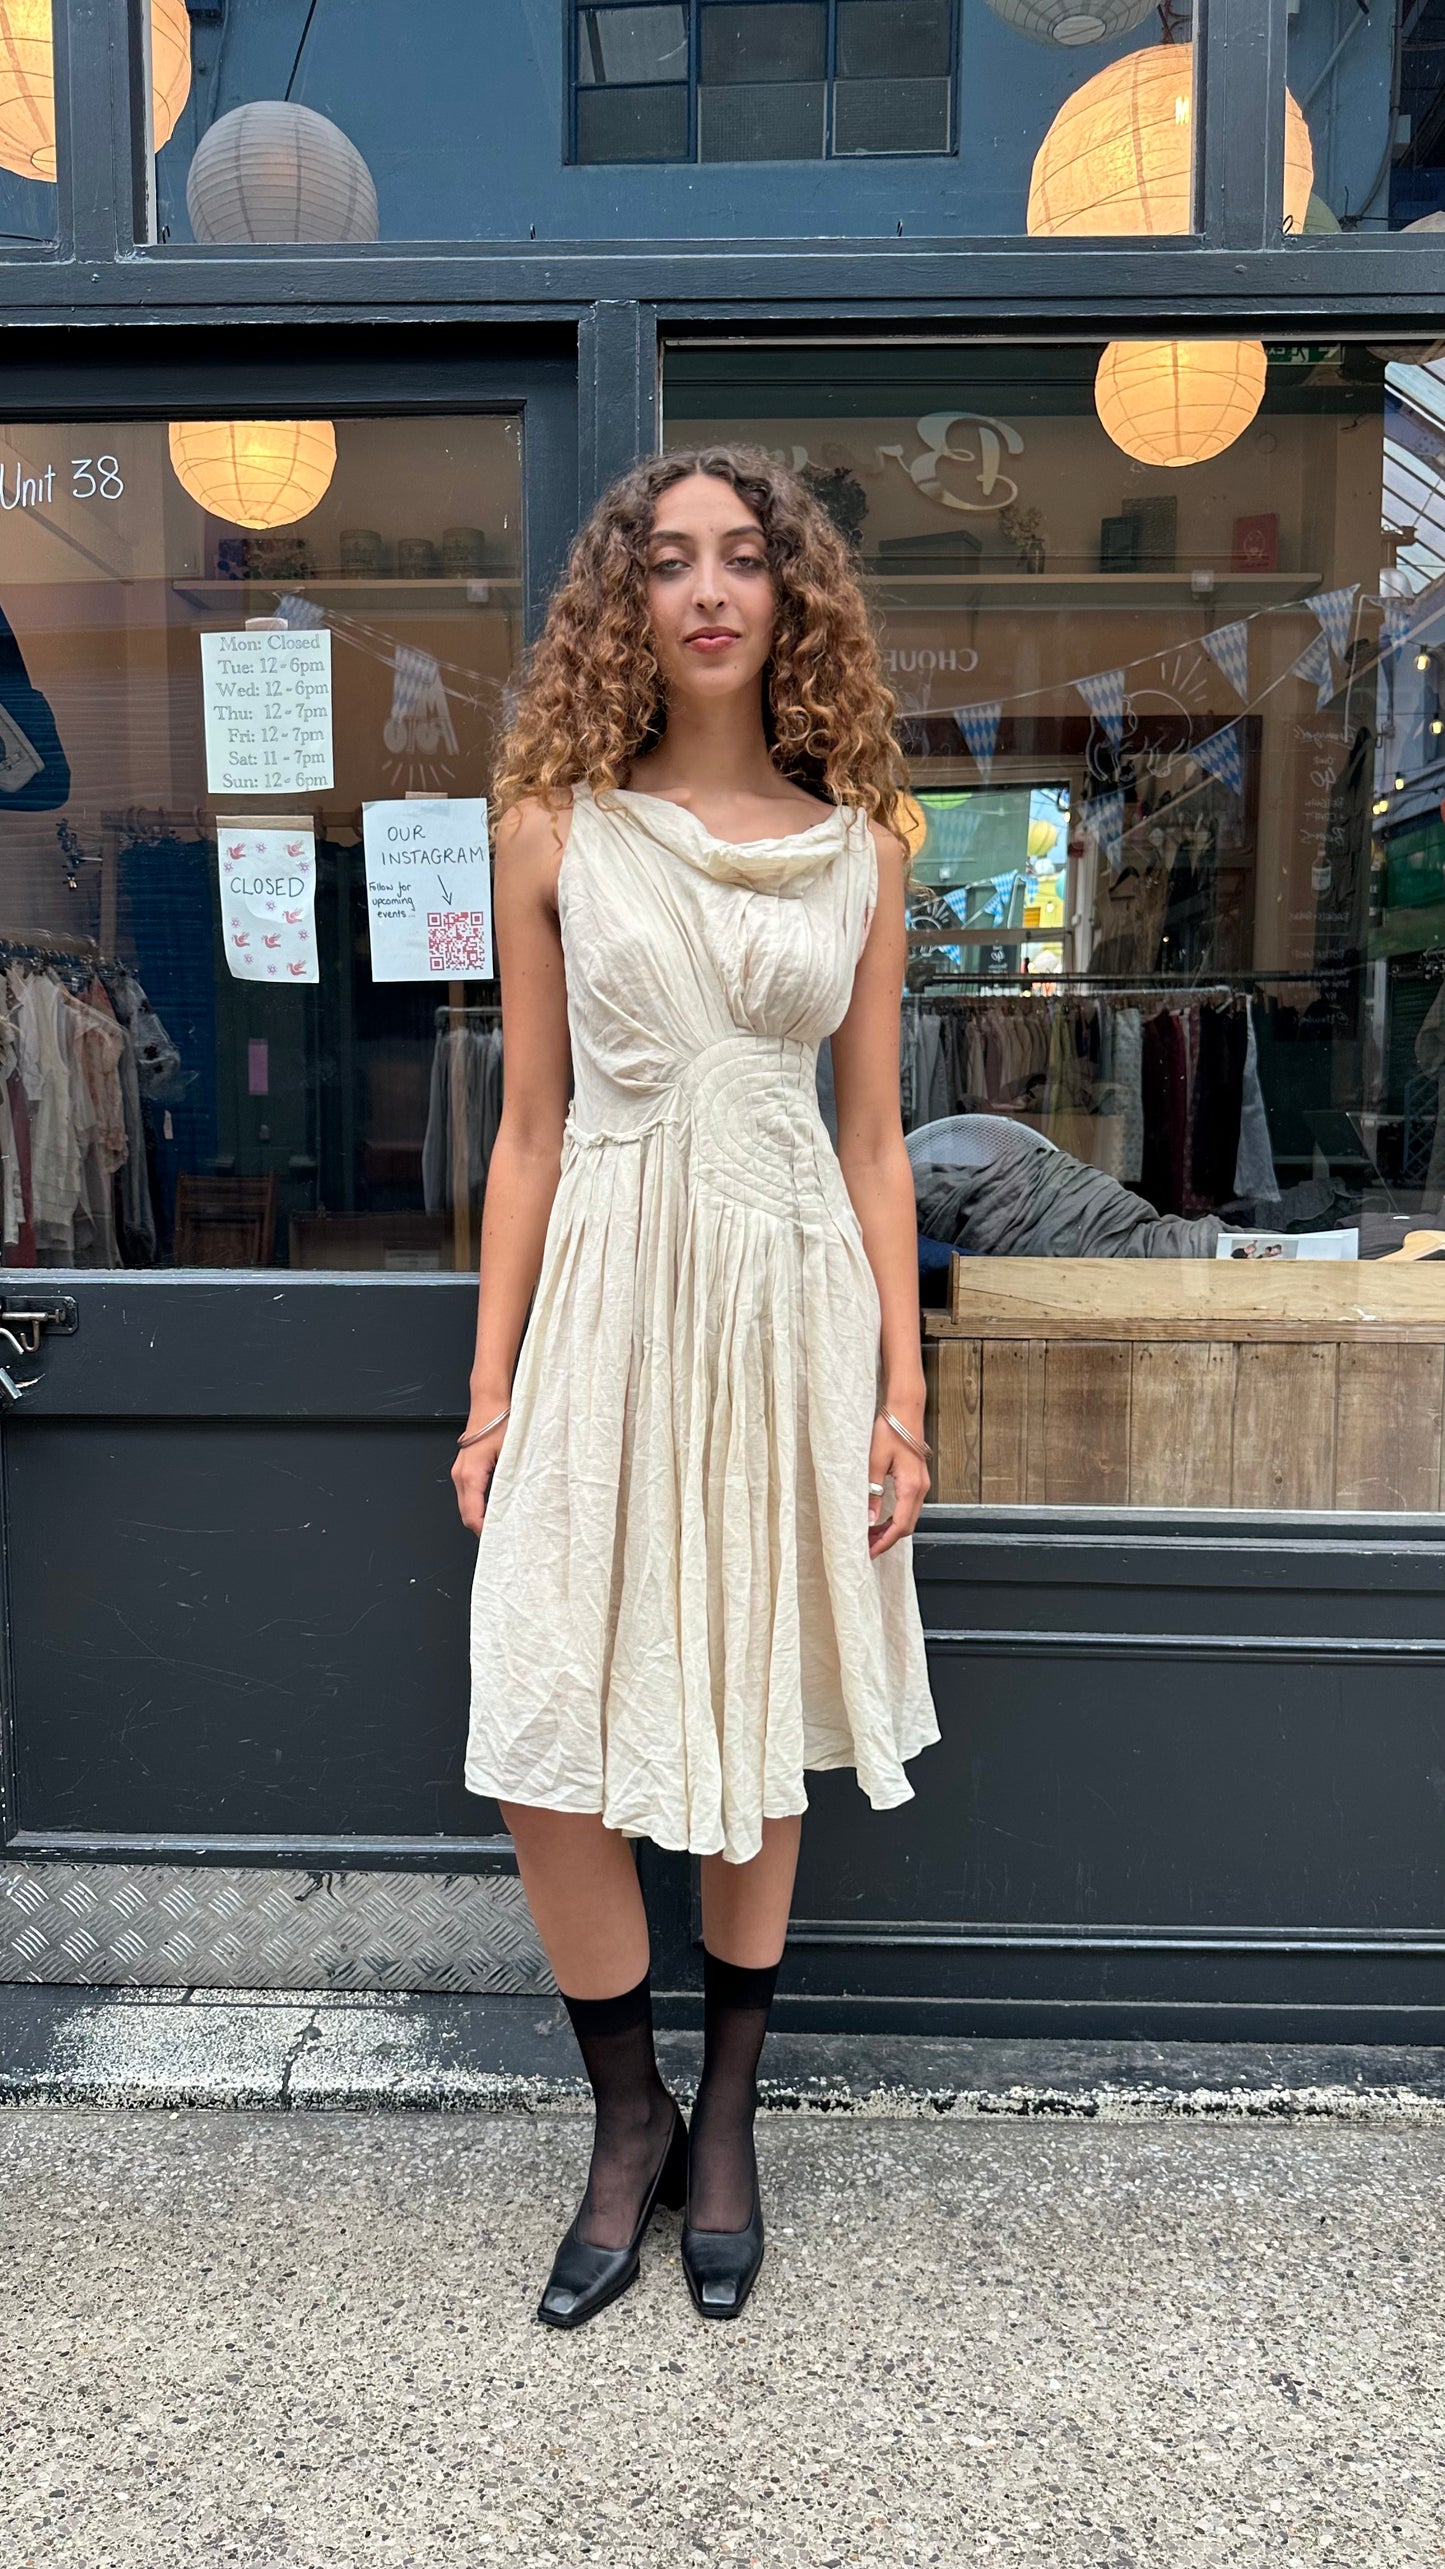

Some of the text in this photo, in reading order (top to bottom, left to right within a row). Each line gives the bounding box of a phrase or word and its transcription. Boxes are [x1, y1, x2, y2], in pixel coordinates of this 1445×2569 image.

[0, 455, 124, 510] Unit 38
[220, 634, 321, 651] Mon: Closed
[218, 660, 254, 674] Tue:
[216, 682, 260, 697] Wed:
[213, 706, 253, 720] Thu:
[228, 728, 255, 742] Fri:
[228, 751, 258, 765] Sat:
[222, 774, 258, 788] Sun:
[387, 825, 426, 841] OUR
[381, 846, 484, 865] INSTAGRAM
[230, 877, 304, 897] CLOSED
[369, 881, 411, 898] Follow for
[371, 897, 415, 912] upcoming
